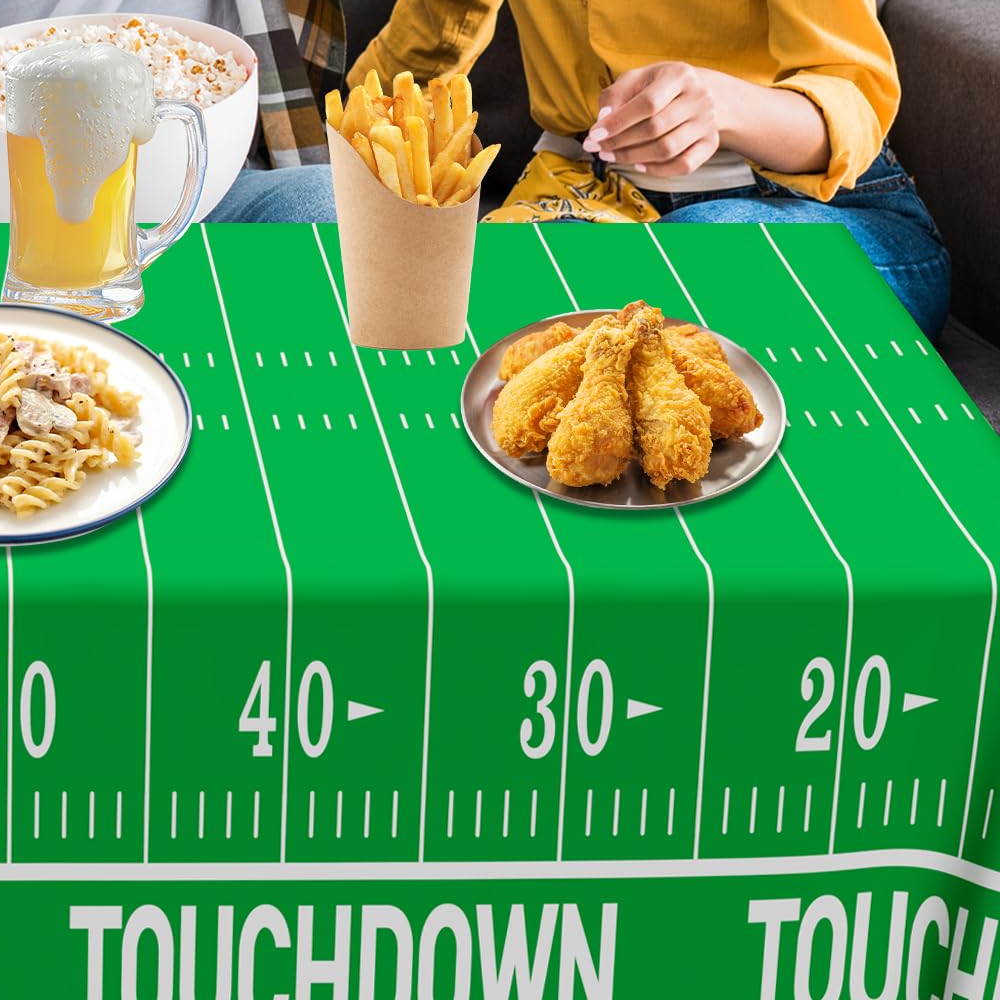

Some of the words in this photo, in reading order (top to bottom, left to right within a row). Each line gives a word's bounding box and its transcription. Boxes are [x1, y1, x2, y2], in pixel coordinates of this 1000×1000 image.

[239, 660, 334, 757] 40
[520, 659, 614, 758] 30
[796, 655, 891, 751] 20
[70, 903, 618, 1000] TOUCHDOWN
[747, 890, 1000, 1000] TOUCH
